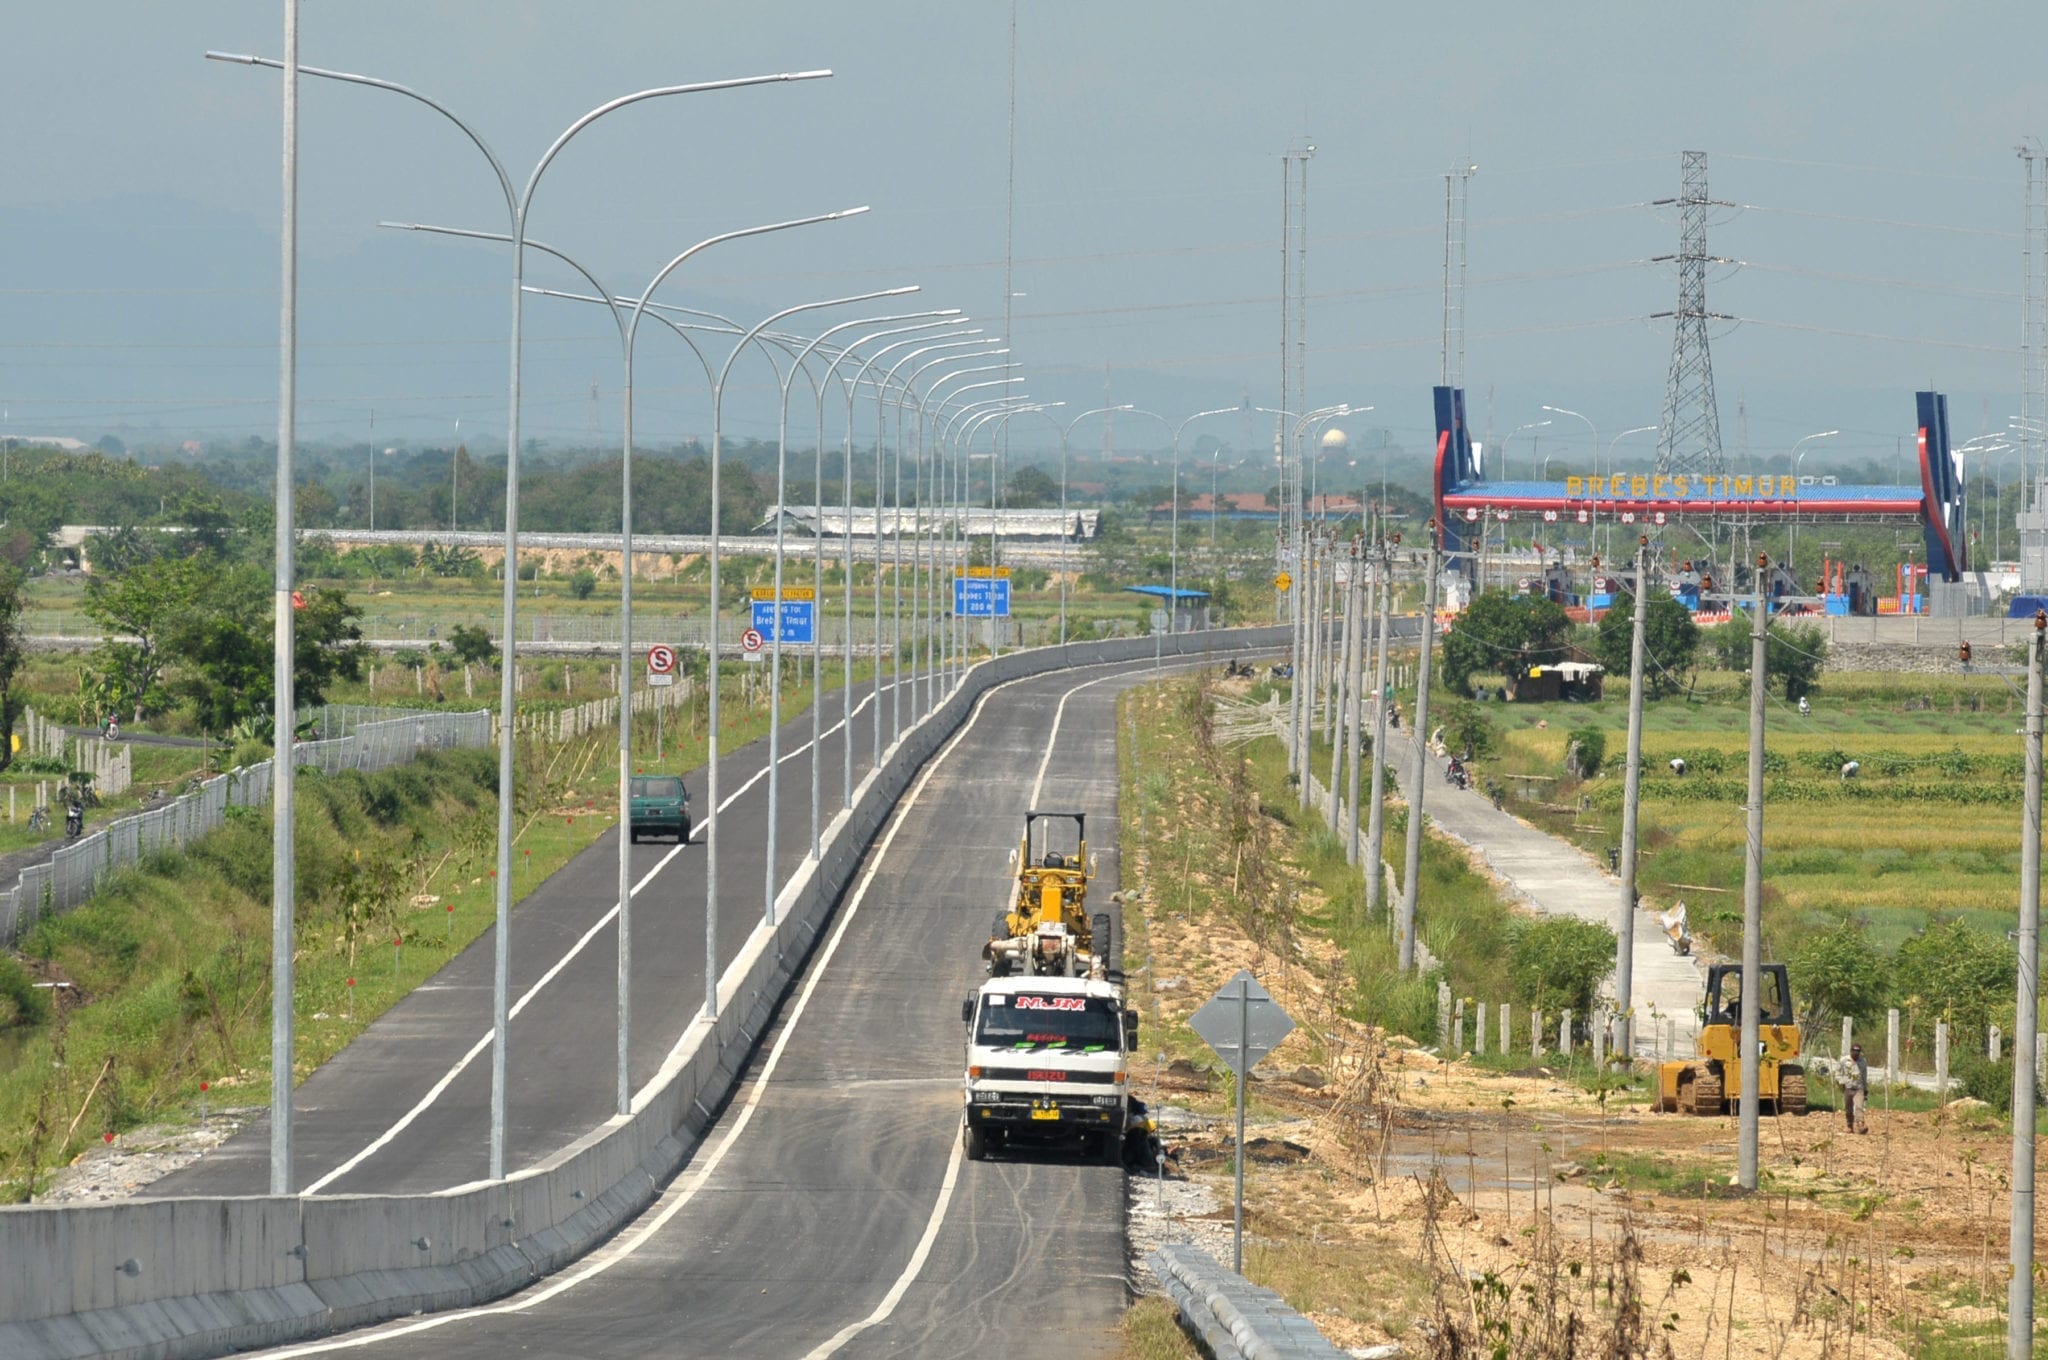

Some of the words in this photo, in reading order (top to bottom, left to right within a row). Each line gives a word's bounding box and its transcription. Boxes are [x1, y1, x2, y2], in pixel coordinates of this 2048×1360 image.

[1567, 475, 1689, 497] BREBES
[1703, 475, 1797, 497] TIMUR
[1026, 1070, 1067, 1082] ISUZU
